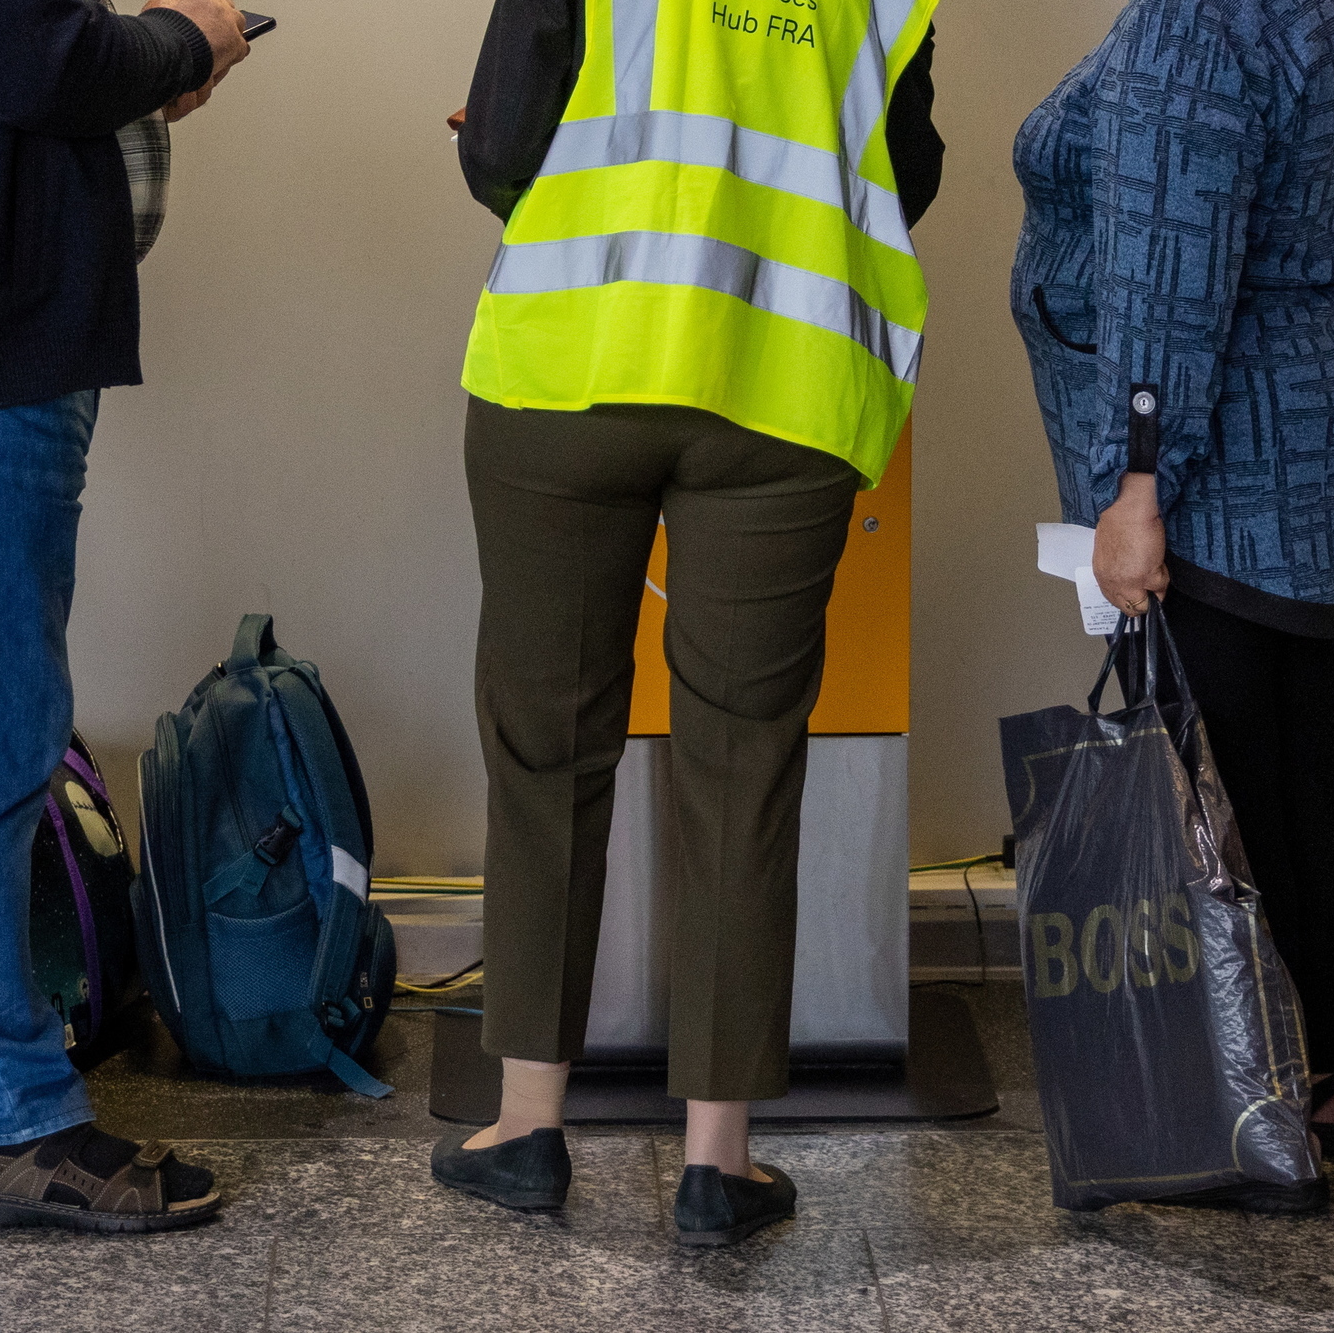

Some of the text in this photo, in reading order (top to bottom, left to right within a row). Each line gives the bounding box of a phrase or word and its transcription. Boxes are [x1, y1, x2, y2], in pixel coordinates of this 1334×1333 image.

[712, 2, 816, 49] Hub FRA
[1032, 893, 1200, 998] BOSS
